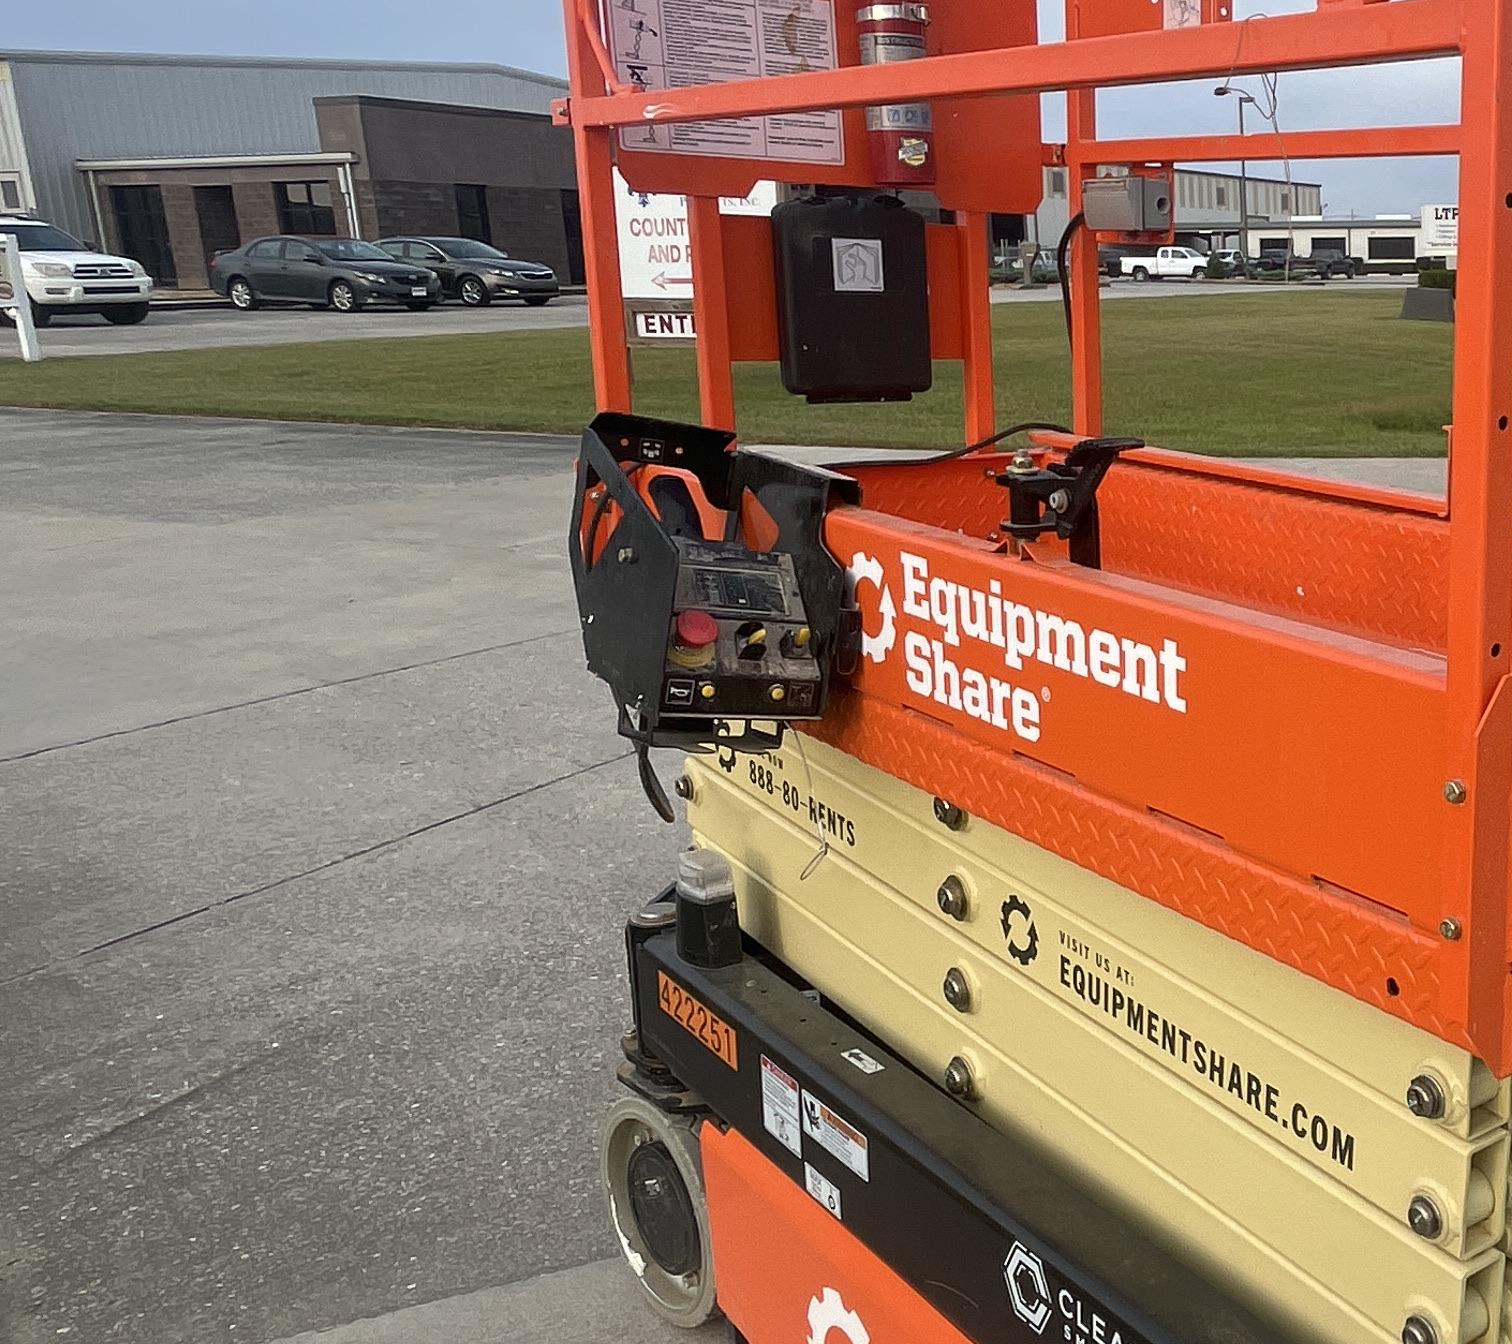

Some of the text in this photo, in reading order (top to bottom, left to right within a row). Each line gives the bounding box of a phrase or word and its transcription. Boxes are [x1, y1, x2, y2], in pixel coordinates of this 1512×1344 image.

[648, 244, 681, 263] AND
[900, 551, 1187, 714] Equipment
[749, 759, 855, 847] 888-80-RENTS
[1059, 929, 1090, 960] VISIT
[1095, 952, 1111, 973] US
[661, 978, 732, 1063] 422251
[1059, 954, 1355, 1172] EQUIPMENTSHARE.COM
